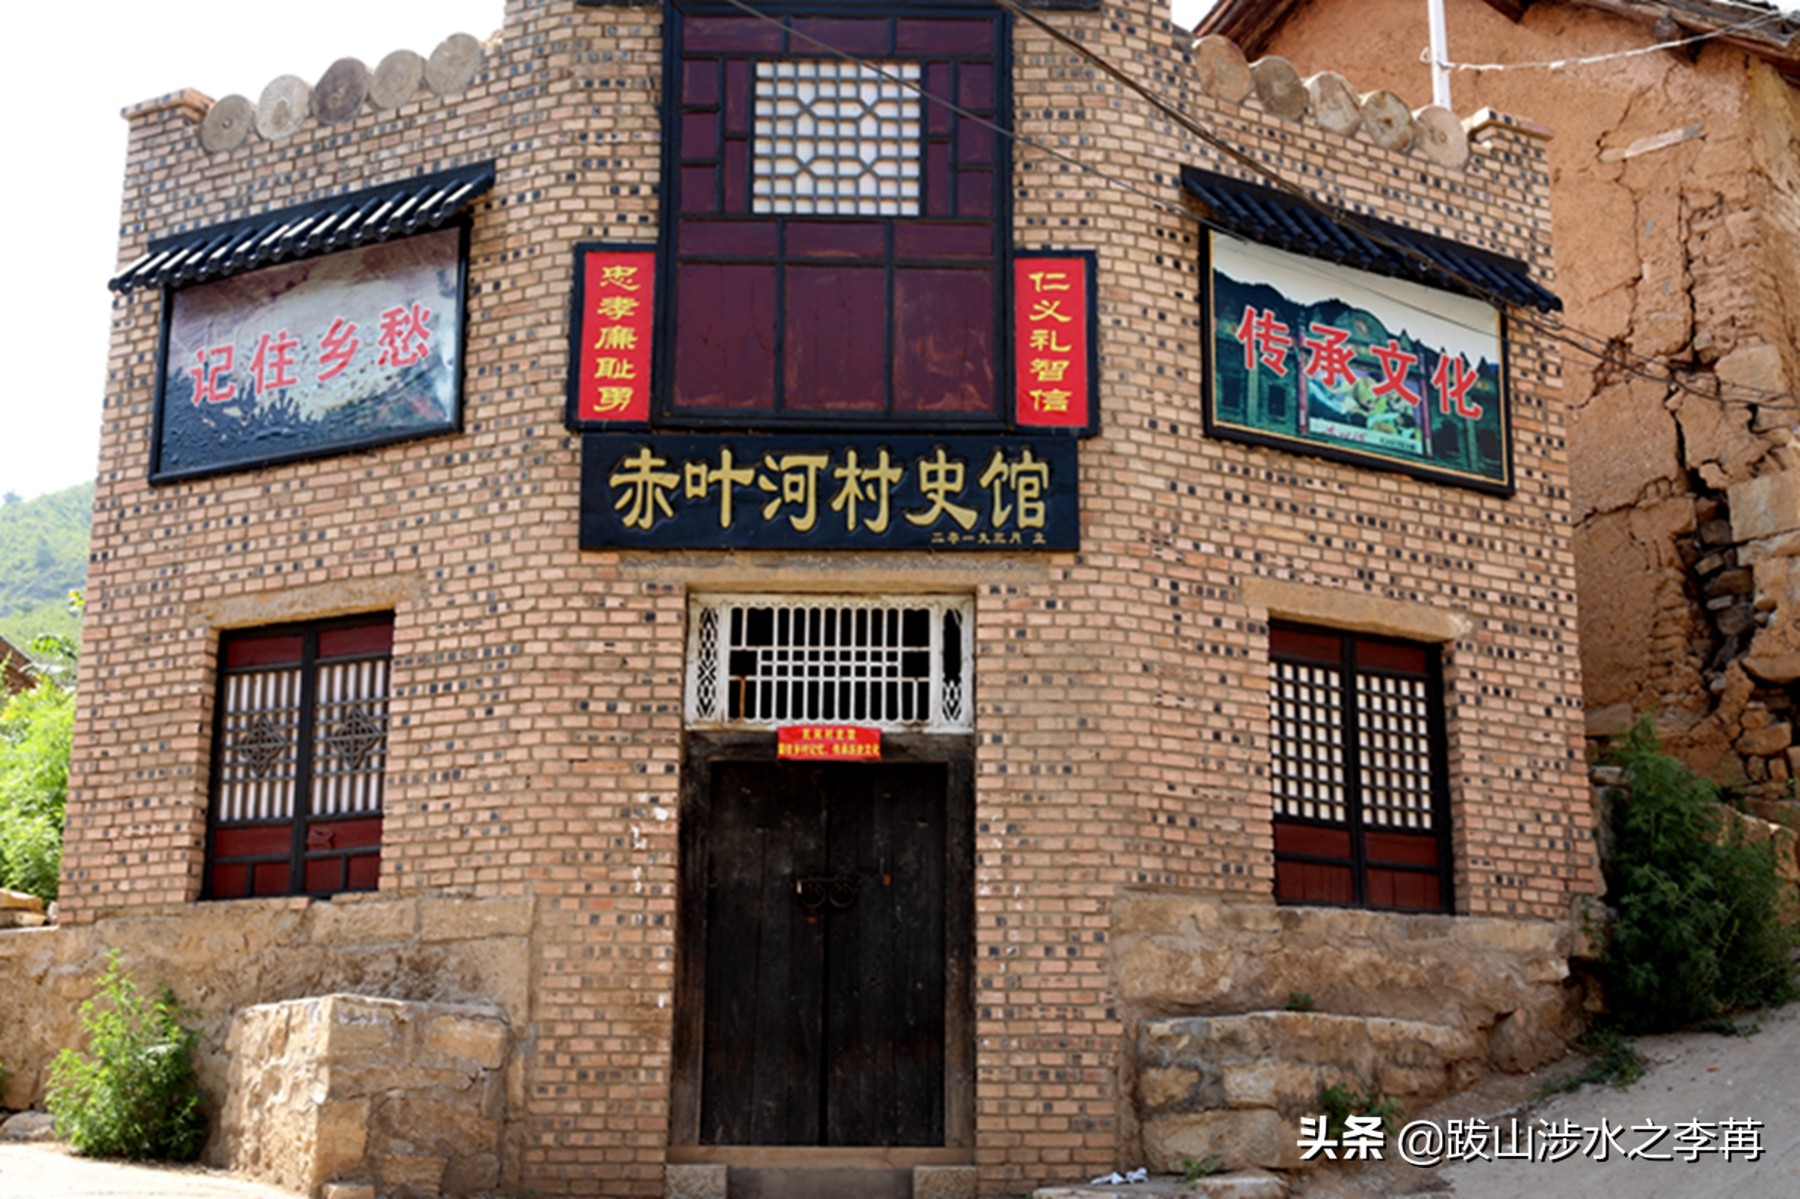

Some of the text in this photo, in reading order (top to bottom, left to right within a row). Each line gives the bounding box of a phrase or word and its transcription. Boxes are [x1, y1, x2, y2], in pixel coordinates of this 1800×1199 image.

[190, 303, 431, 405] 记住乡愁
[593, 265, 641, 412] 忠孝廉耻勇
[1027, 271, 1073, 412] 仁义礼智信
[1236, 305, 1483, 420] 传承文化
[609, 448, 1047, 533] 赤叶河村史馆
